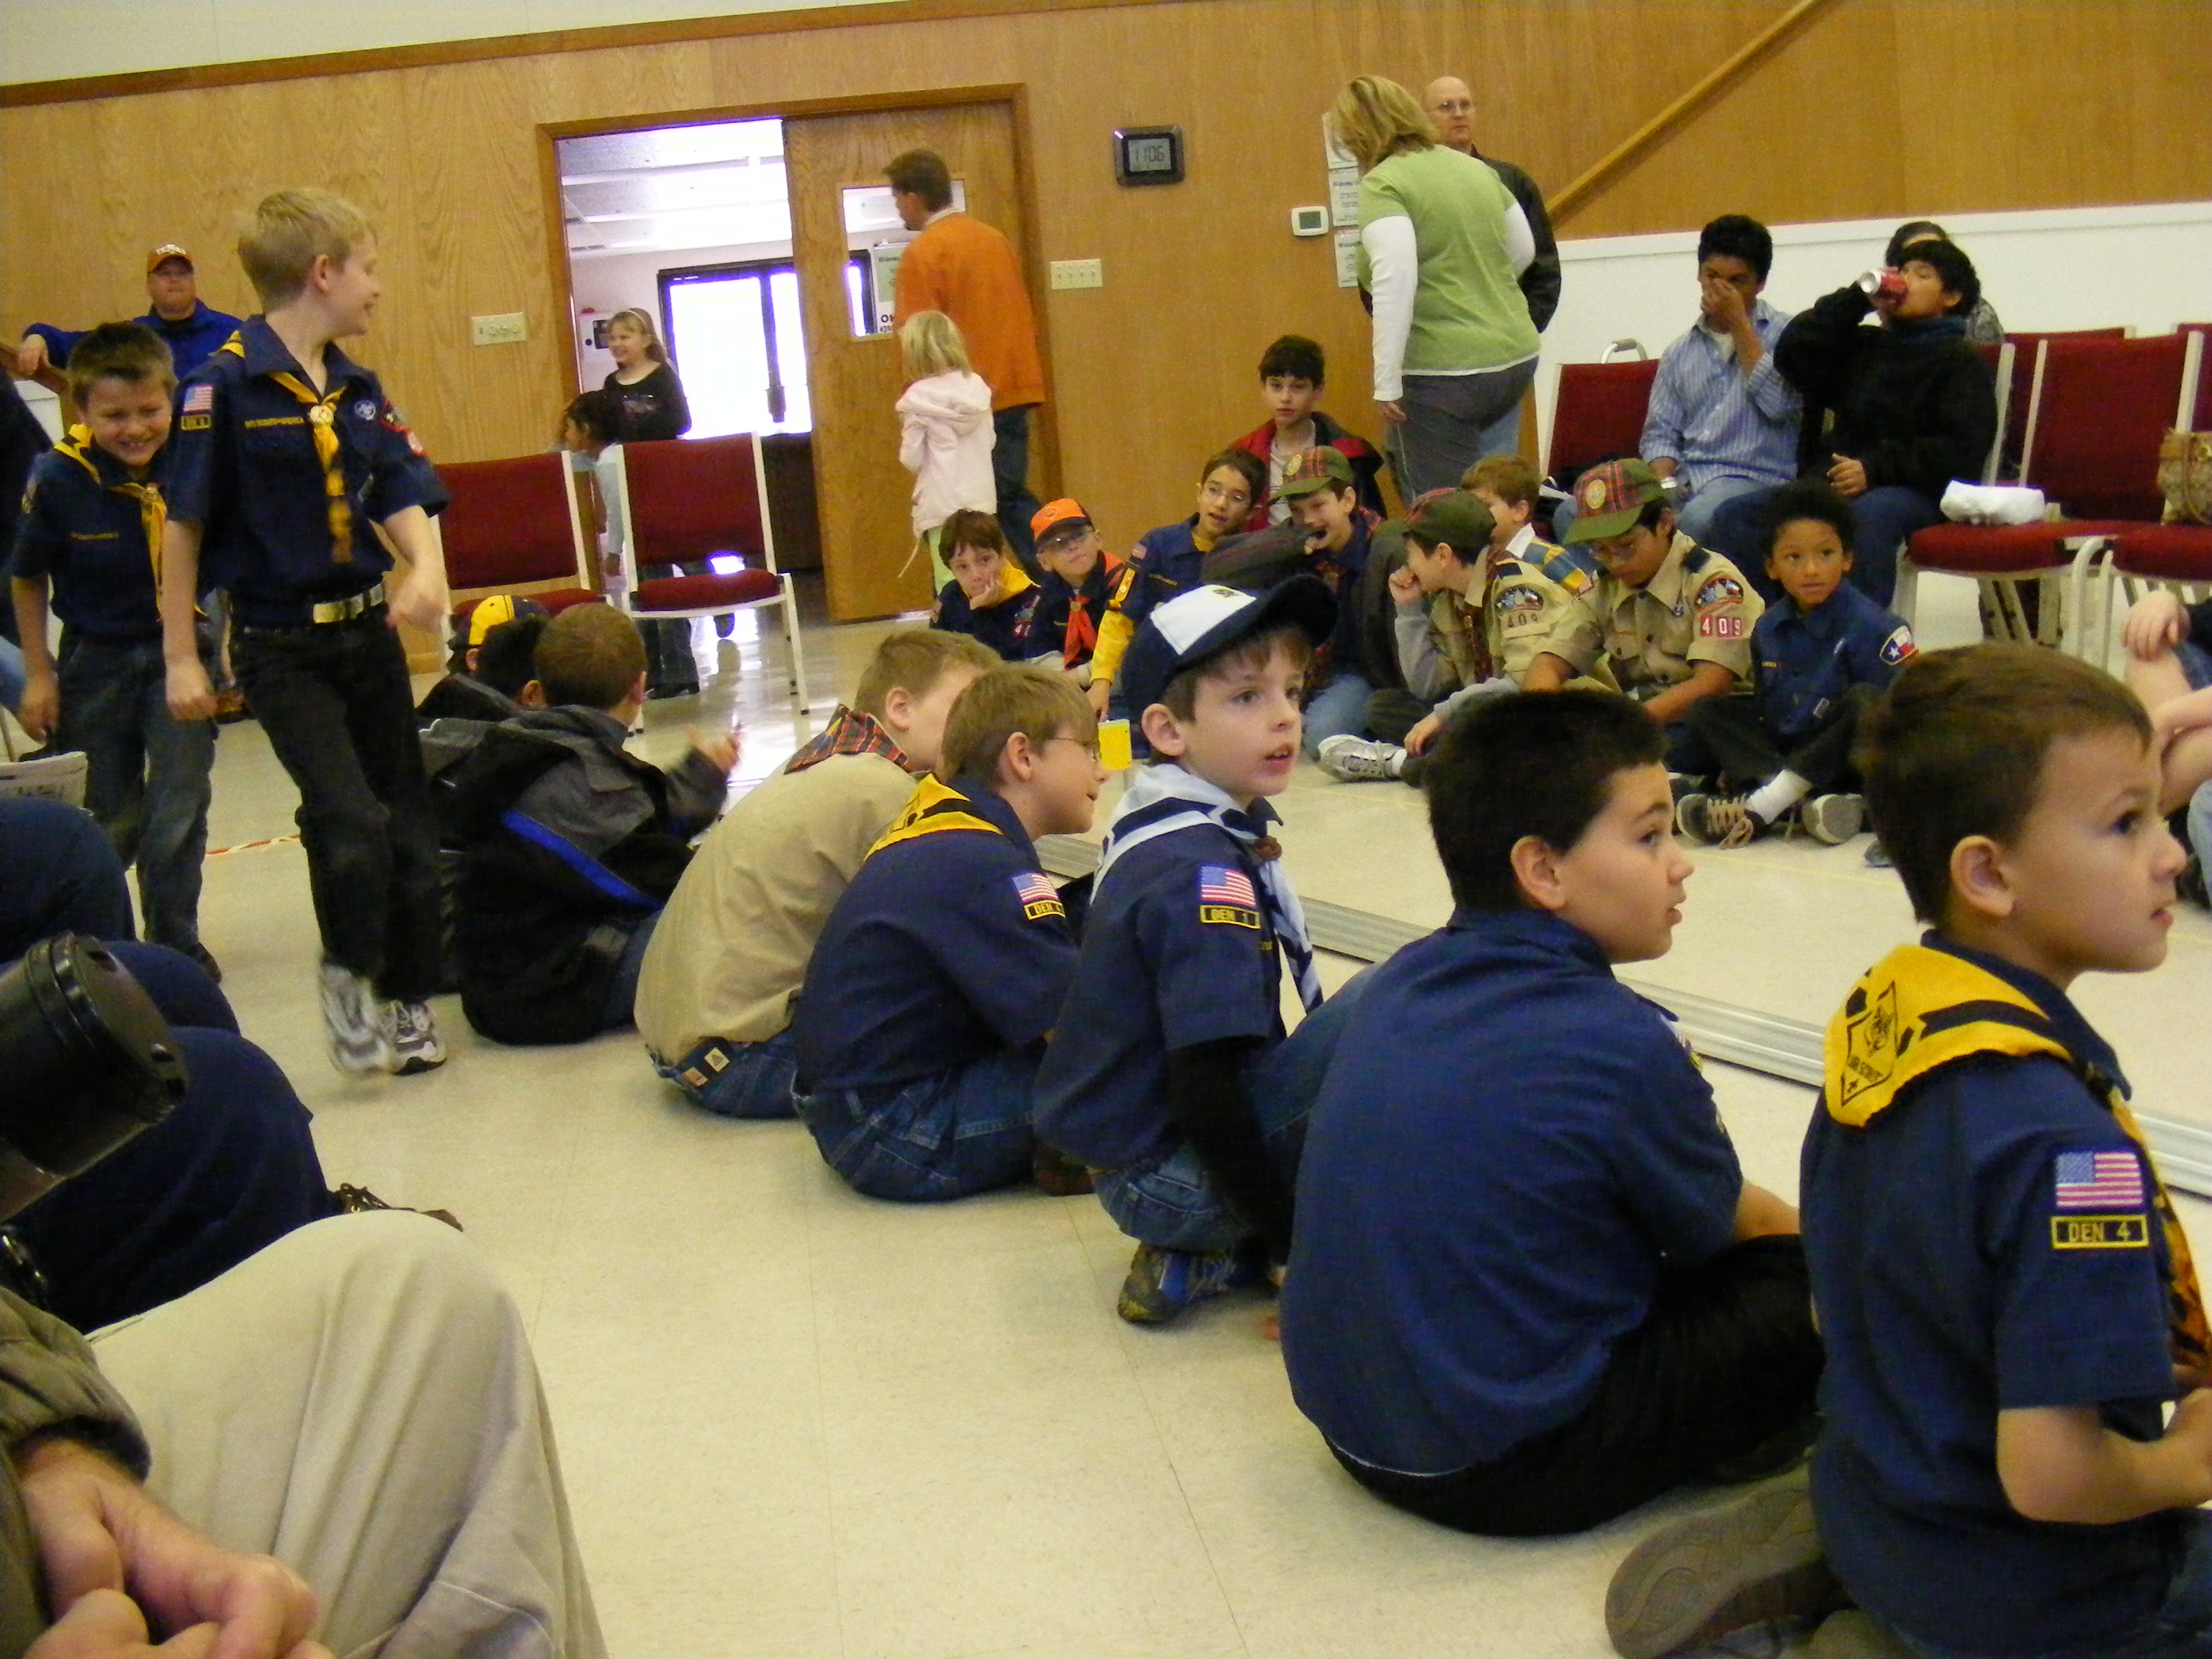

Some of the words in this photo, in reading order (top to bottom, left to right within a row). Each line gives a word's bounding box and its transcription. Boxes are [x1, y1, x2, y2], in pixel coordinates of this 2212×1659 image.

[1702, 617, 1741, 635] 409
[2068, 1221, 2104, 1243] DEN
[2117, 1221, 2131, 1242] 4
